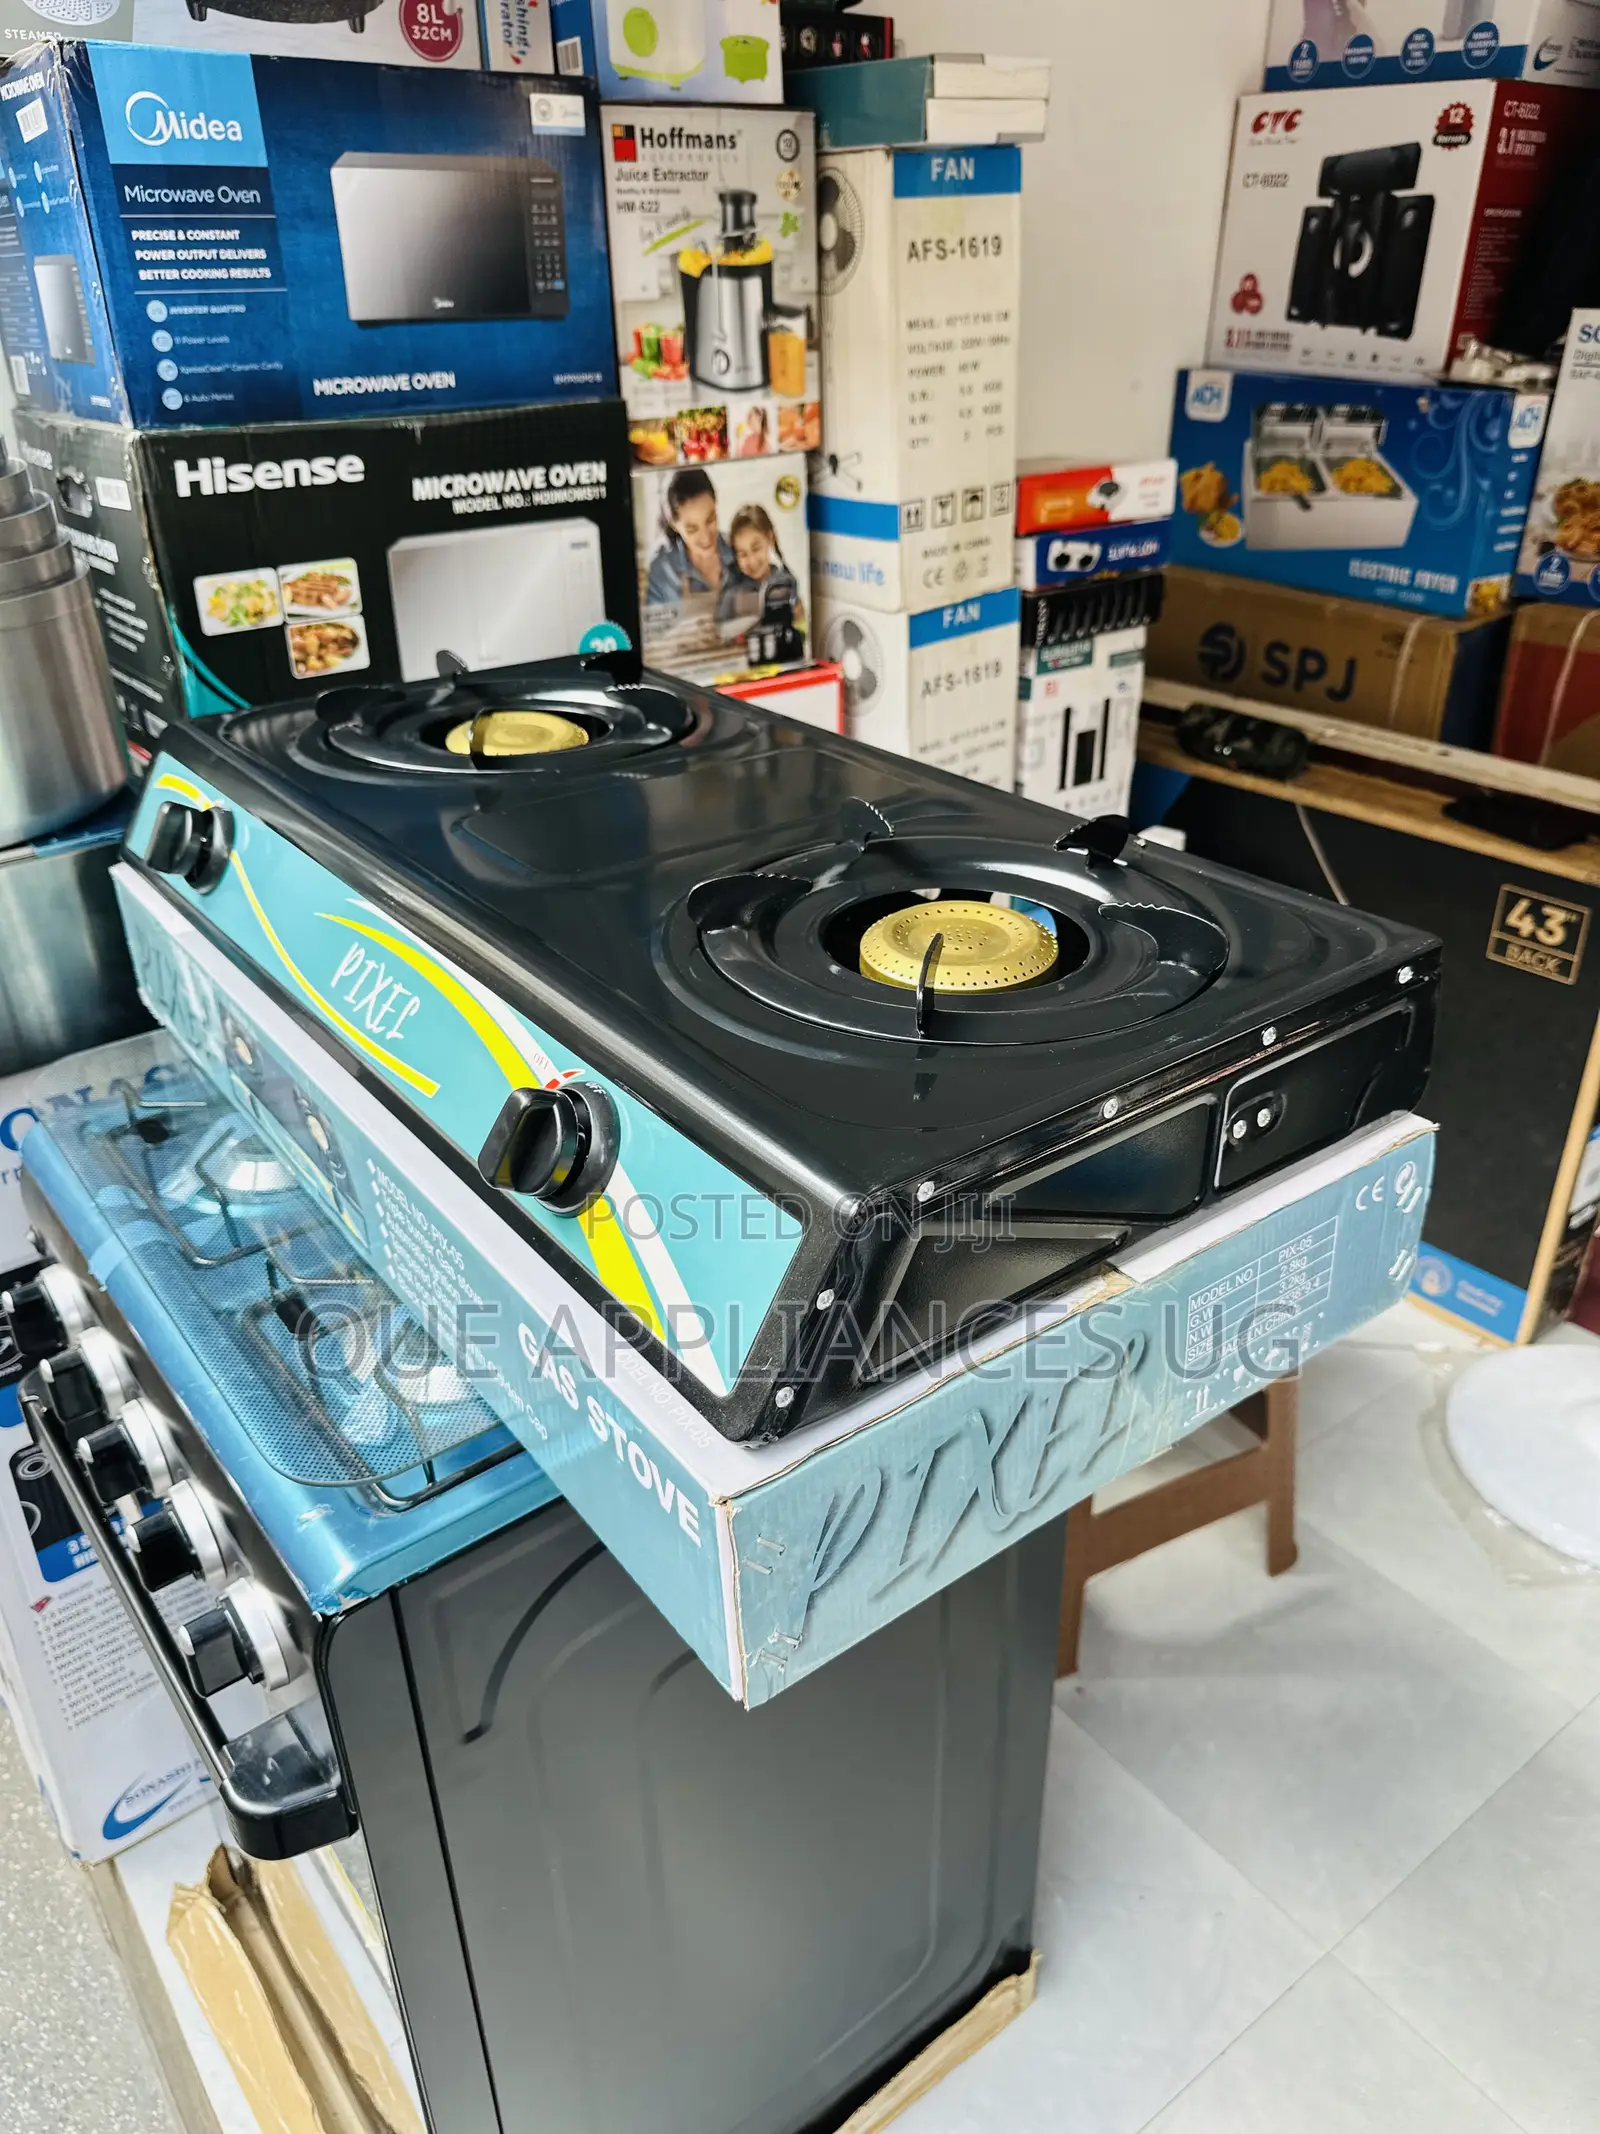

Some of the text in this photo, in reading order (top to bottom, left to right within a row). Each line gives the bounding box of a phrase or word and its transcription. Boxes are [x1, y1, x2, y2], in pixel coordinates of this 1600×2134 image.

[416, 3, 445, 25] 8L
[411, 24, 453, 42] 32CM
[125, 90, 243, 147] Midea
[1251, 108, 1304, 134] CTC
[640, 126, 738, 150] Hoffmans
[615, 167, 709, 182] Juice Extractor
[930, 156, 975, 182] FAN
[123, 184, 262, 204] Microwave Oven
[131, 229, 240, 242] PRECISE & CONSTANT
[135, 248, 267, 261] POWER OUTPUT DELIVERS
[906, 234, 1003, 264] AFS-1619
[138, 267, 272, 281] BETTER COOKING RESULTS
[312, 370, 456, 397] MICROWAVE OVEN
[173, 453, 366, 498] Hisense
[411, 460, 608, 502] MICROWAVE OVEN
[452, 493, 502, 515] MODEL
[857, 562, 885, 587] life
[942, 602, 981, 629] FAN
[1260, 639, 1358, 704] SPJ
[1278, 1235, 1314, 1263] PIX-05
[1279, 1256, 1308, 1279] 2.8kg
[1189, 1268, 1254, 1313] MODEL NO
[1279, 1271, 1306, 1294] 3.2kg
[1189, 1306, 1213, 1328] G.W
[1187, 1336, 1214, 1363] SIZE
[518, 1322, 702, 1549] GAS STOVE
[668, 1403, 716, 1450] PIX-05
